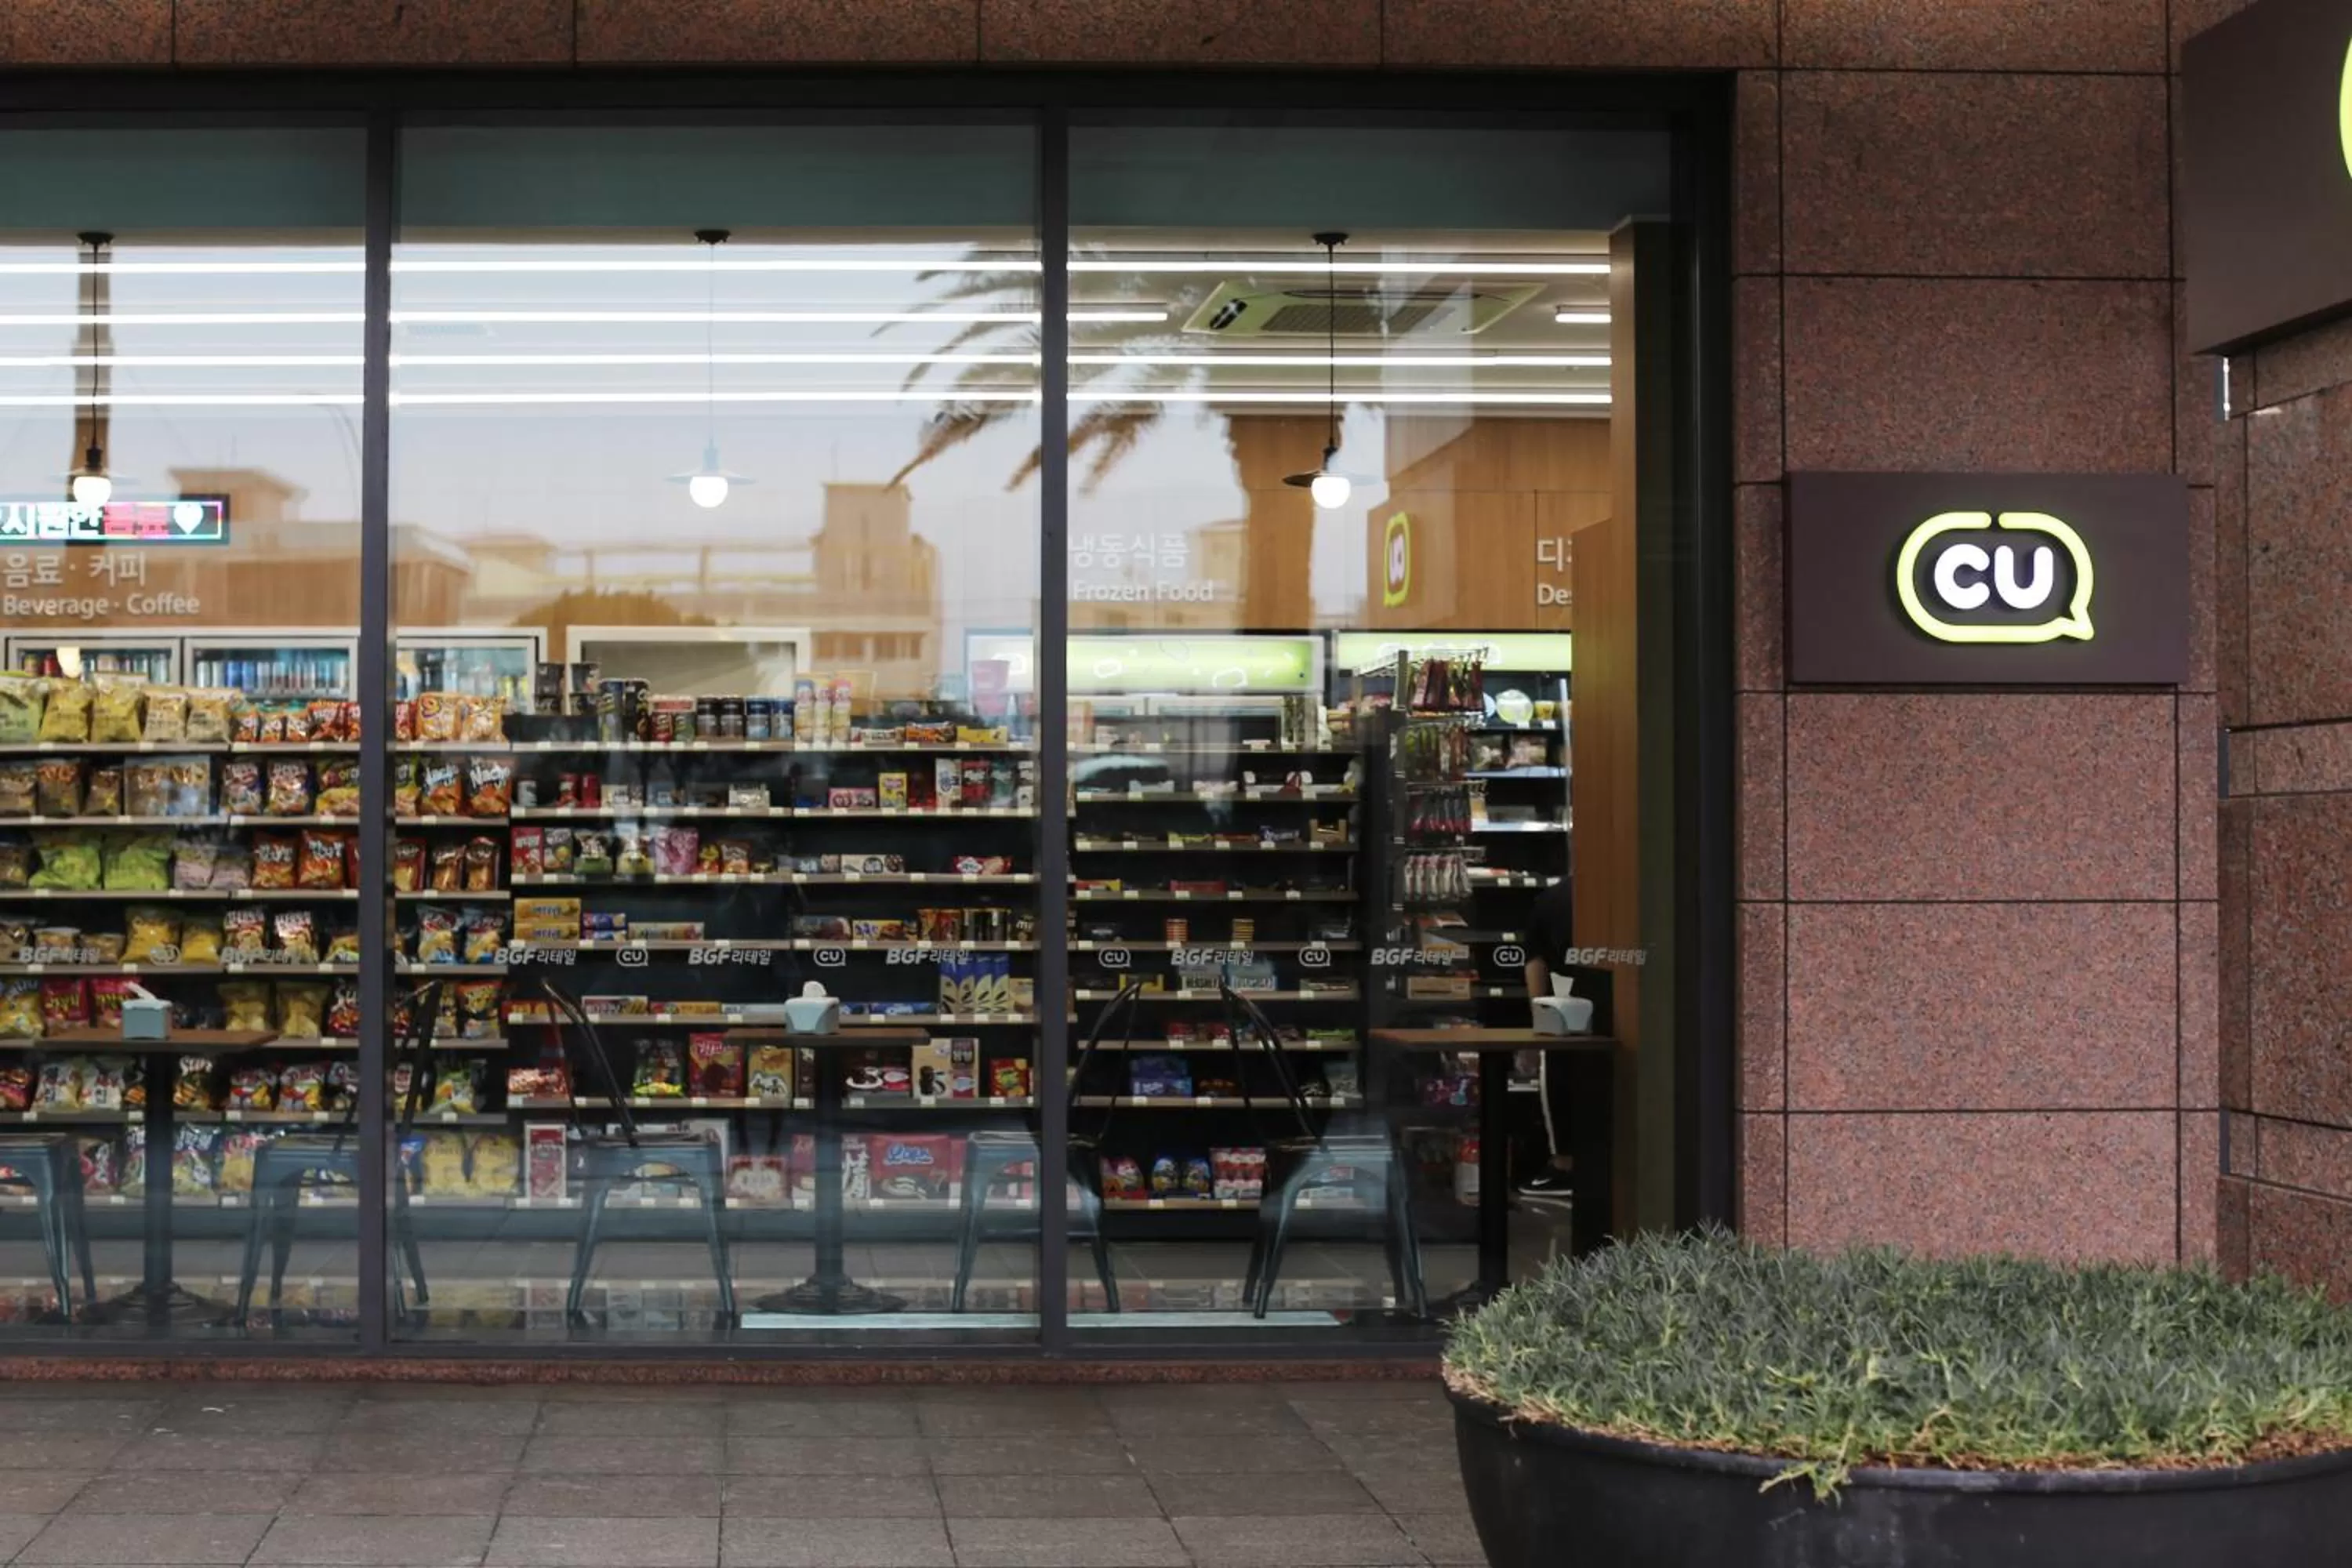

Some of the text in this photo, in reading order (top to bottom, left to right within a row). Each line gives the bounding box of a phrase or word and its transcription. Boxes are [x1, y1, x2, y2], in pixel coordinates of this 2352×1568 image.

[1069, 533, 1190, 568] 냉동식품
[1537, 537, 1572, 572] 디
[2, 551, 147, 587] 음료 커피
[1934, 543, 2053, 609] CU
[1074, 579, 1214, 601] Frozen Food
[2, 593, 200, 619] Beverage Coffee
[494, 948, 576, 965] BGF리테일
[688, 948, 771, 965] BGF리테일
[886, 949, 969, 964] BGF리테일
[1171, 949, 1254, 966] BGF리테일
[1371, 948, 1452, 965] BGF리테일
[1565, 947, 1645, 965] BGF리테일
